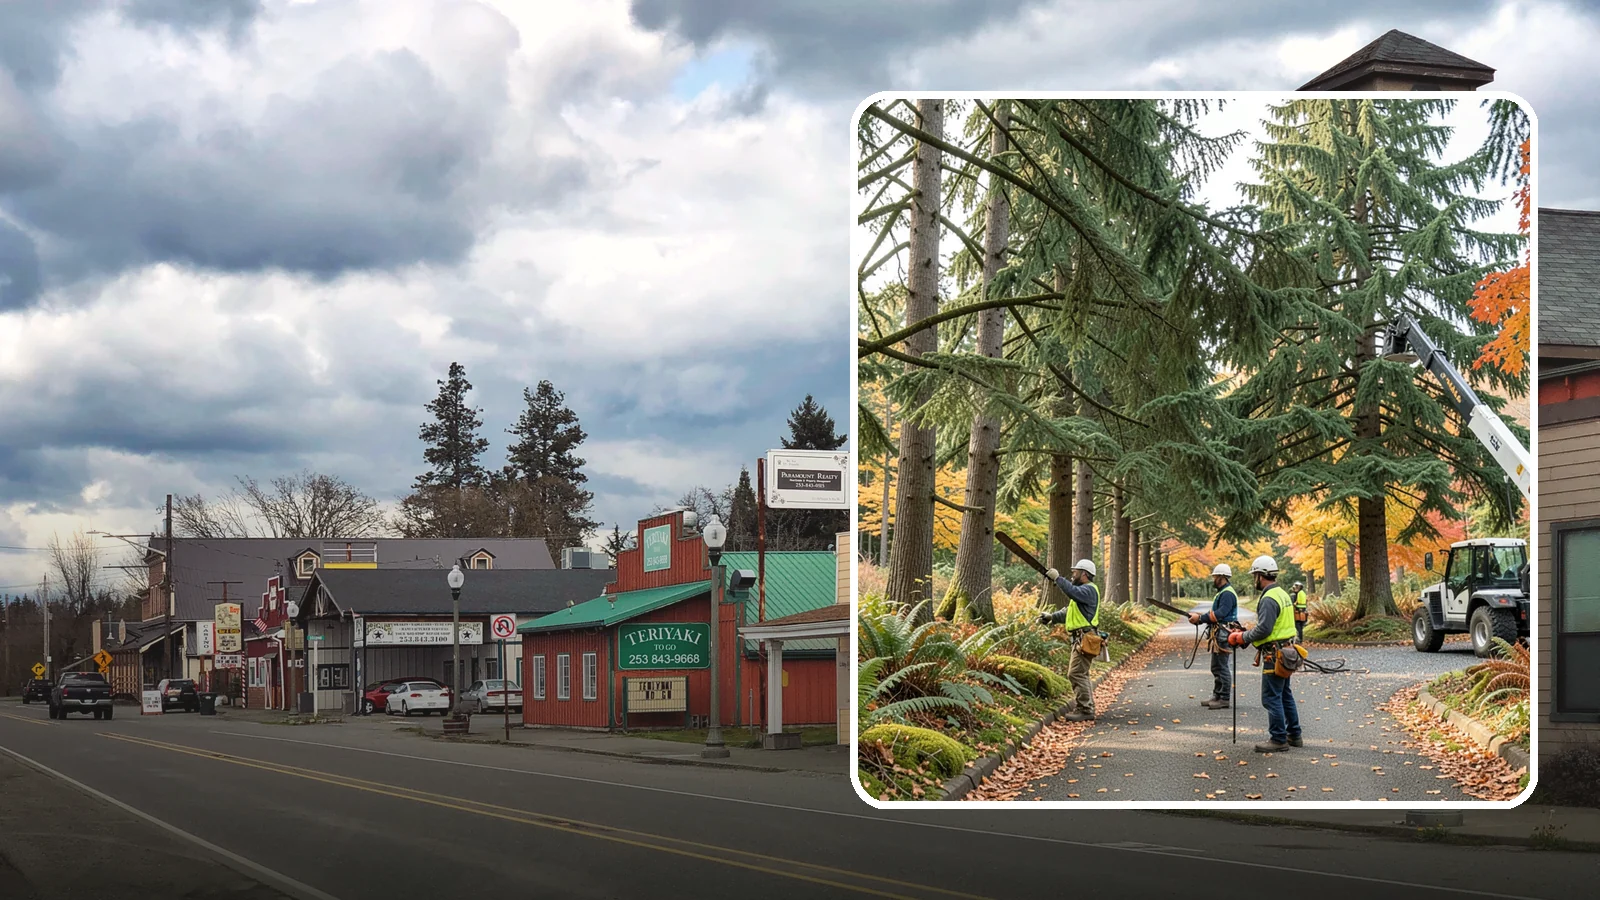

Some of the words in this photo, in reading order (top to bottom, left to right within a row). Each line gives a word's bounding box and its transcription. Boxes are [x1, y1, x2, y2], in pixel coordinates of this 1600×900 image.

[624, 627, 703, 646] TERIYAKI
[629, 654, 649, 665] 253
[651, 653, 700, 664] 843-9668
